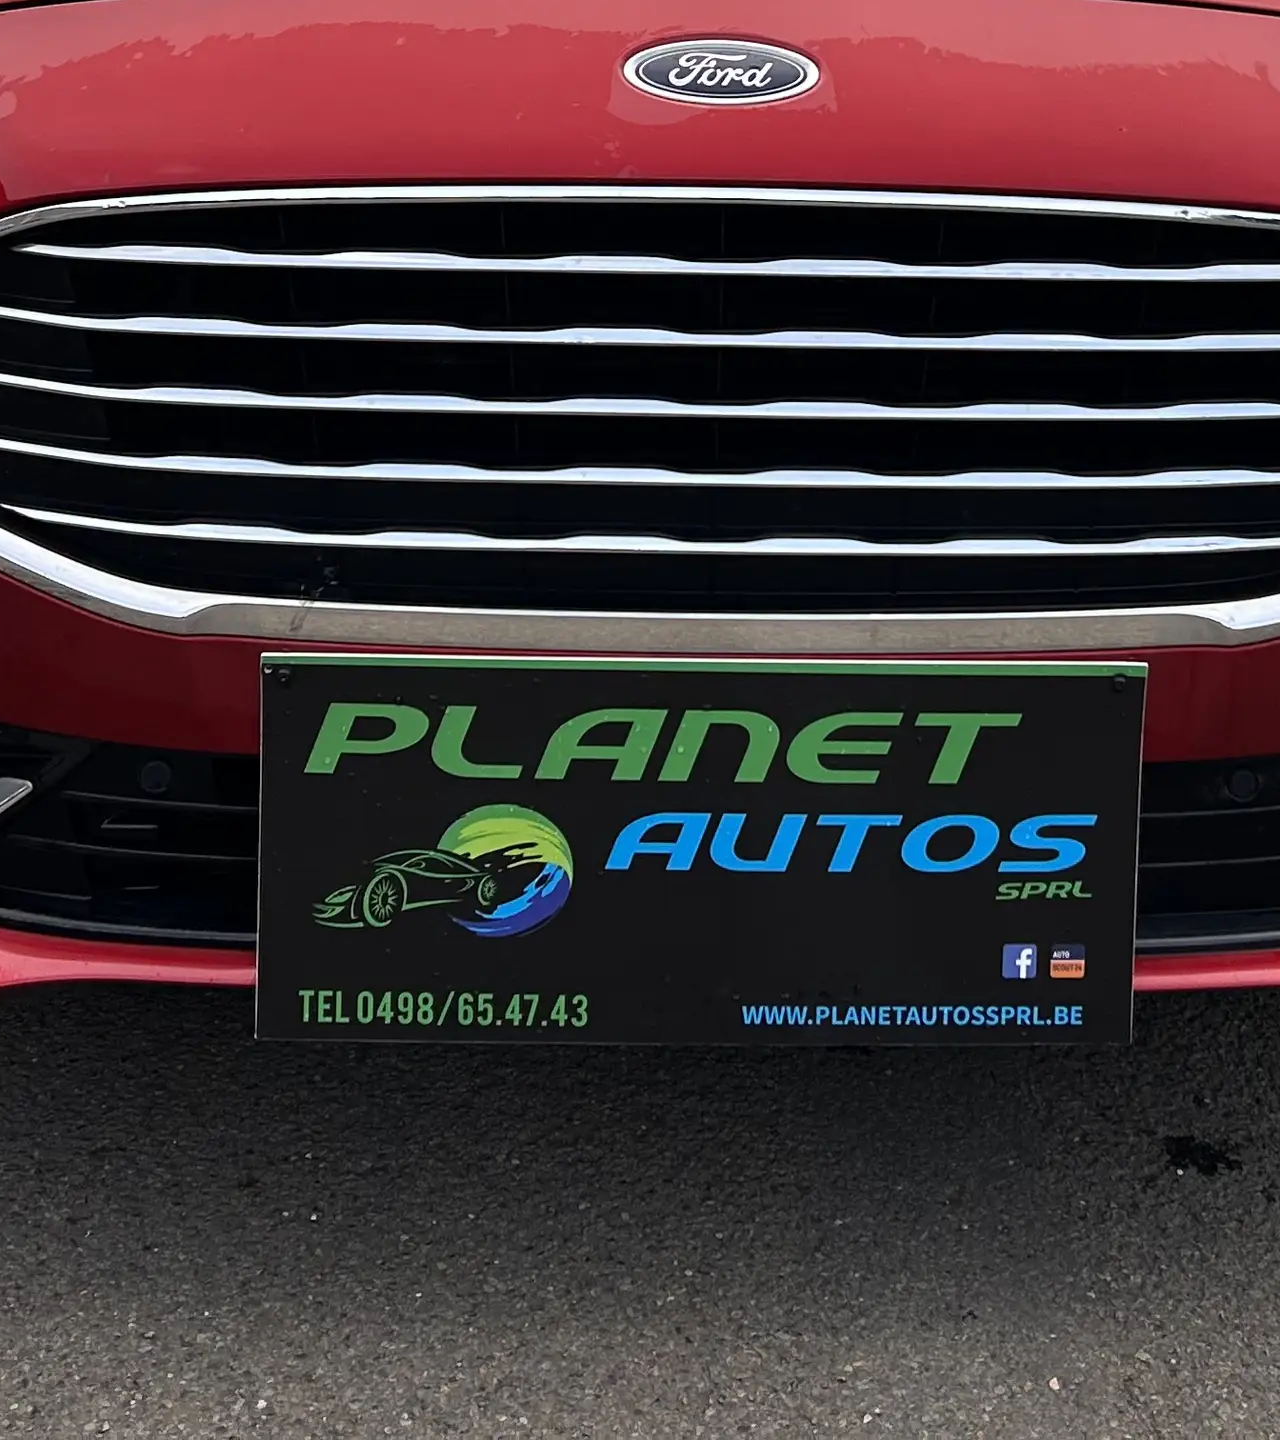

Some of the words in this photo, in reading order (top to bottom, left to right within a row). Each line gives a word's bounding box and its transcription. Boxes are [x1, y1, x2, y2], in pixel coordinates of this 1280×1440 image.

[668, 52, 773, 87] Ford
[303, 702, 1023, 785] PLANET
[604, 812, 1099, 873] AUTOS
[995, 880, 1093, 900] SPRL
[1052, 951, 1070, 959] AUTO
[299, 990, 350, 1024] TEL
[356, 991, 589, 1029] 0498/65.47.43
[741, 1005, 1084, 1027] WWW.PLANETAUTOSSPRL.BE
